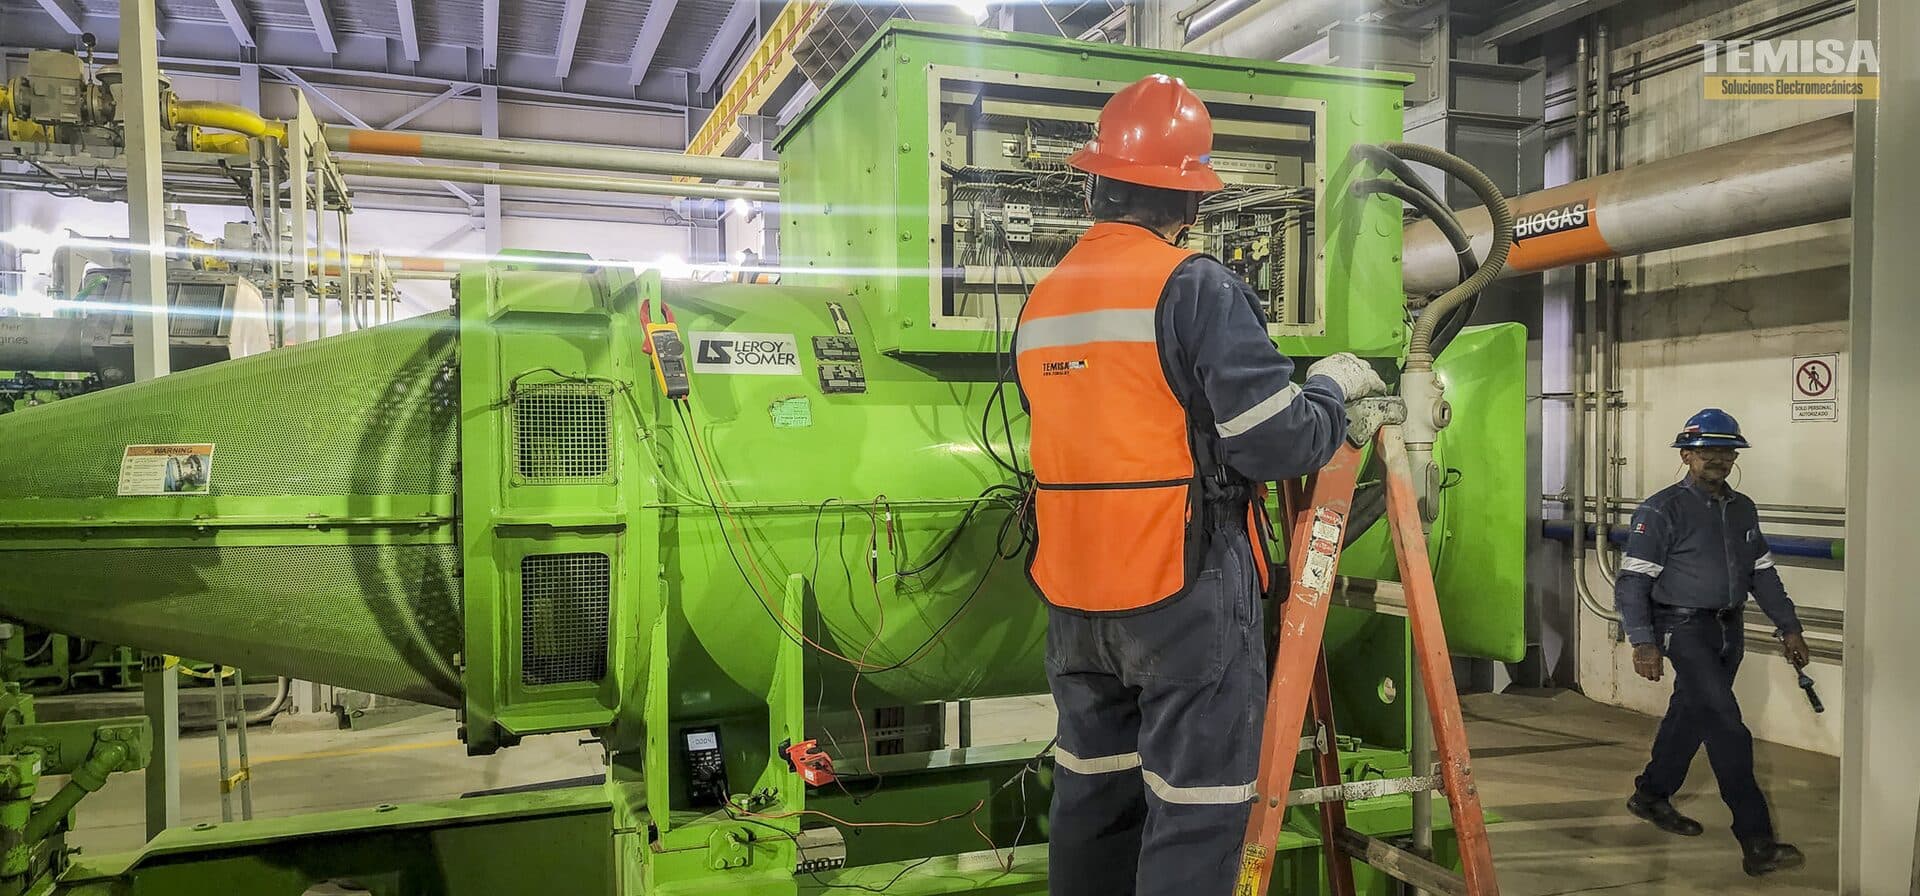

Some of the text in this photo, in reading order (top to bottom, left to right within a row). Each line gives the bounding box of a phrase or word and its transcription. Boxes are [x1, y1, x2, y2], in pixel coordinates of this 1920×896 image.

[1516, 204, 1585, 237] BIOGAS
[735, 340, 785, 353] LEROY
[734, 352, 796, 366] SOMER
[1042, 361, 1070, 371] TEMISA
